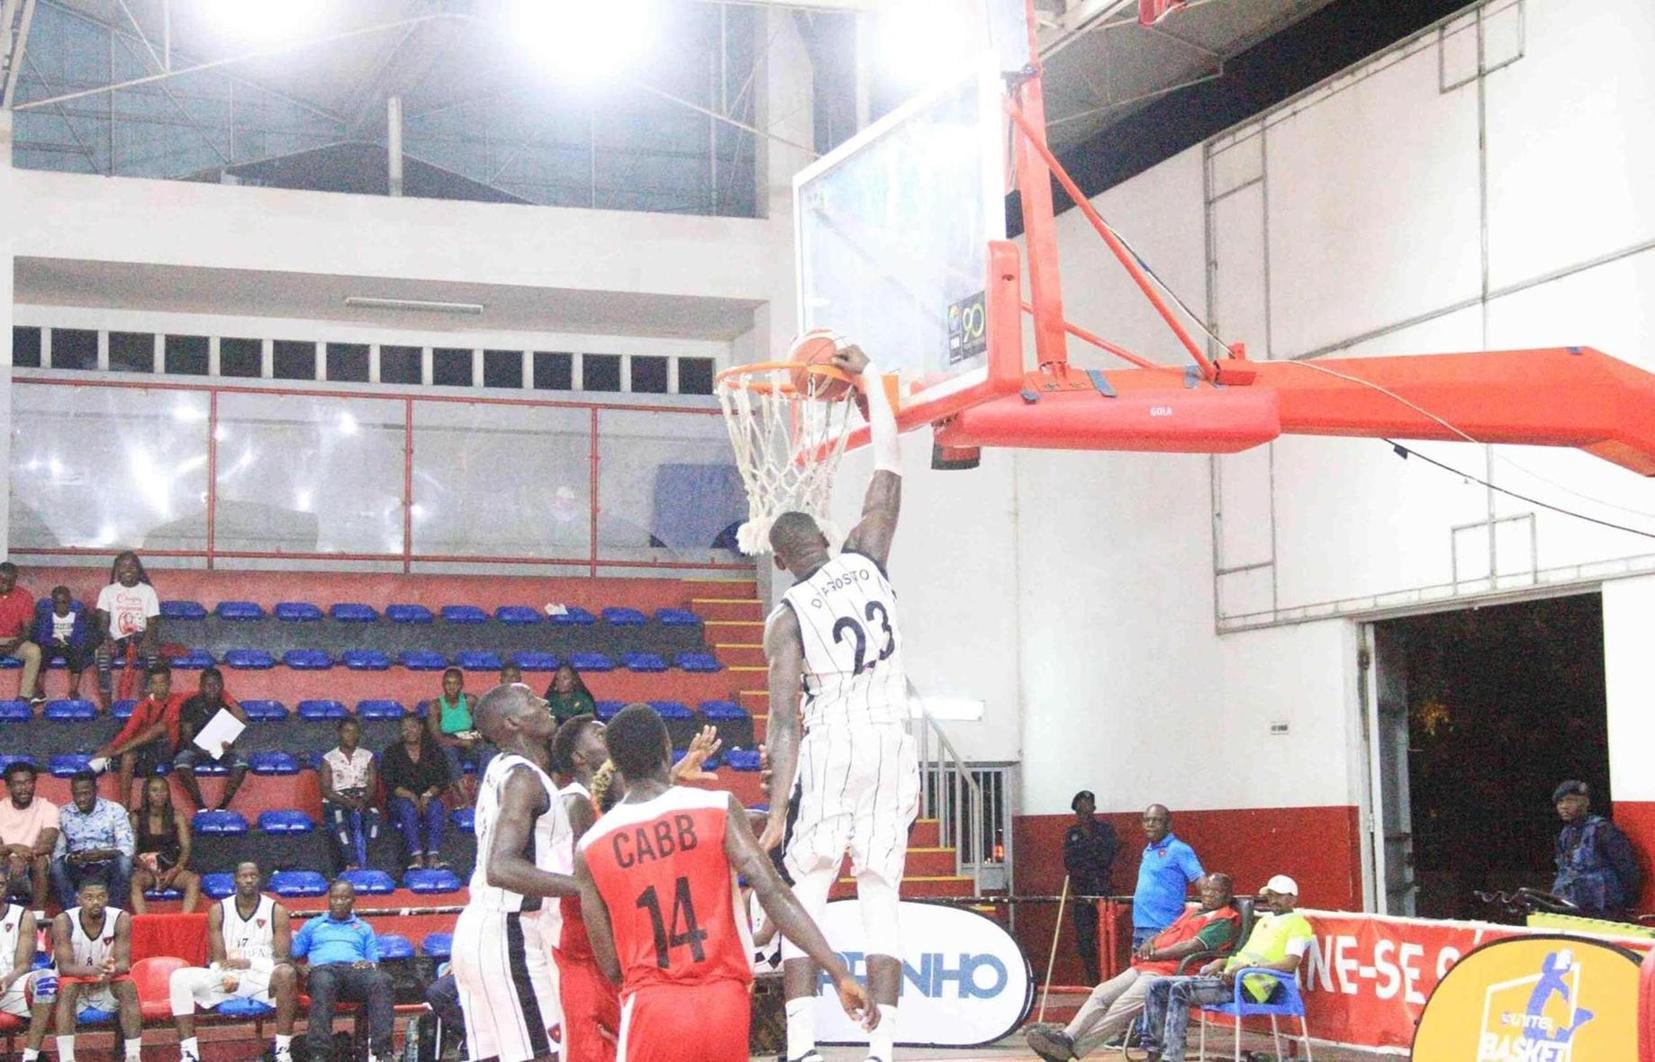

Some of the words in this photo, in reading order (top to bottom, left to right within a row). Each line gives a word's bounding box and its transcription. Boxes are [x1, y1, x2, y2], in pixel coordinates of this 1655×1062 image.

[962, 303, 985, 343] 90
[832, 600, 896, 676] 23
[612, 813, 698, 869] CABB
[635, 876, 709, 969] 14
[1297, 934, 1427, 1005] NE-SE
[1481, 1032, 1569, 1062] BASKET
